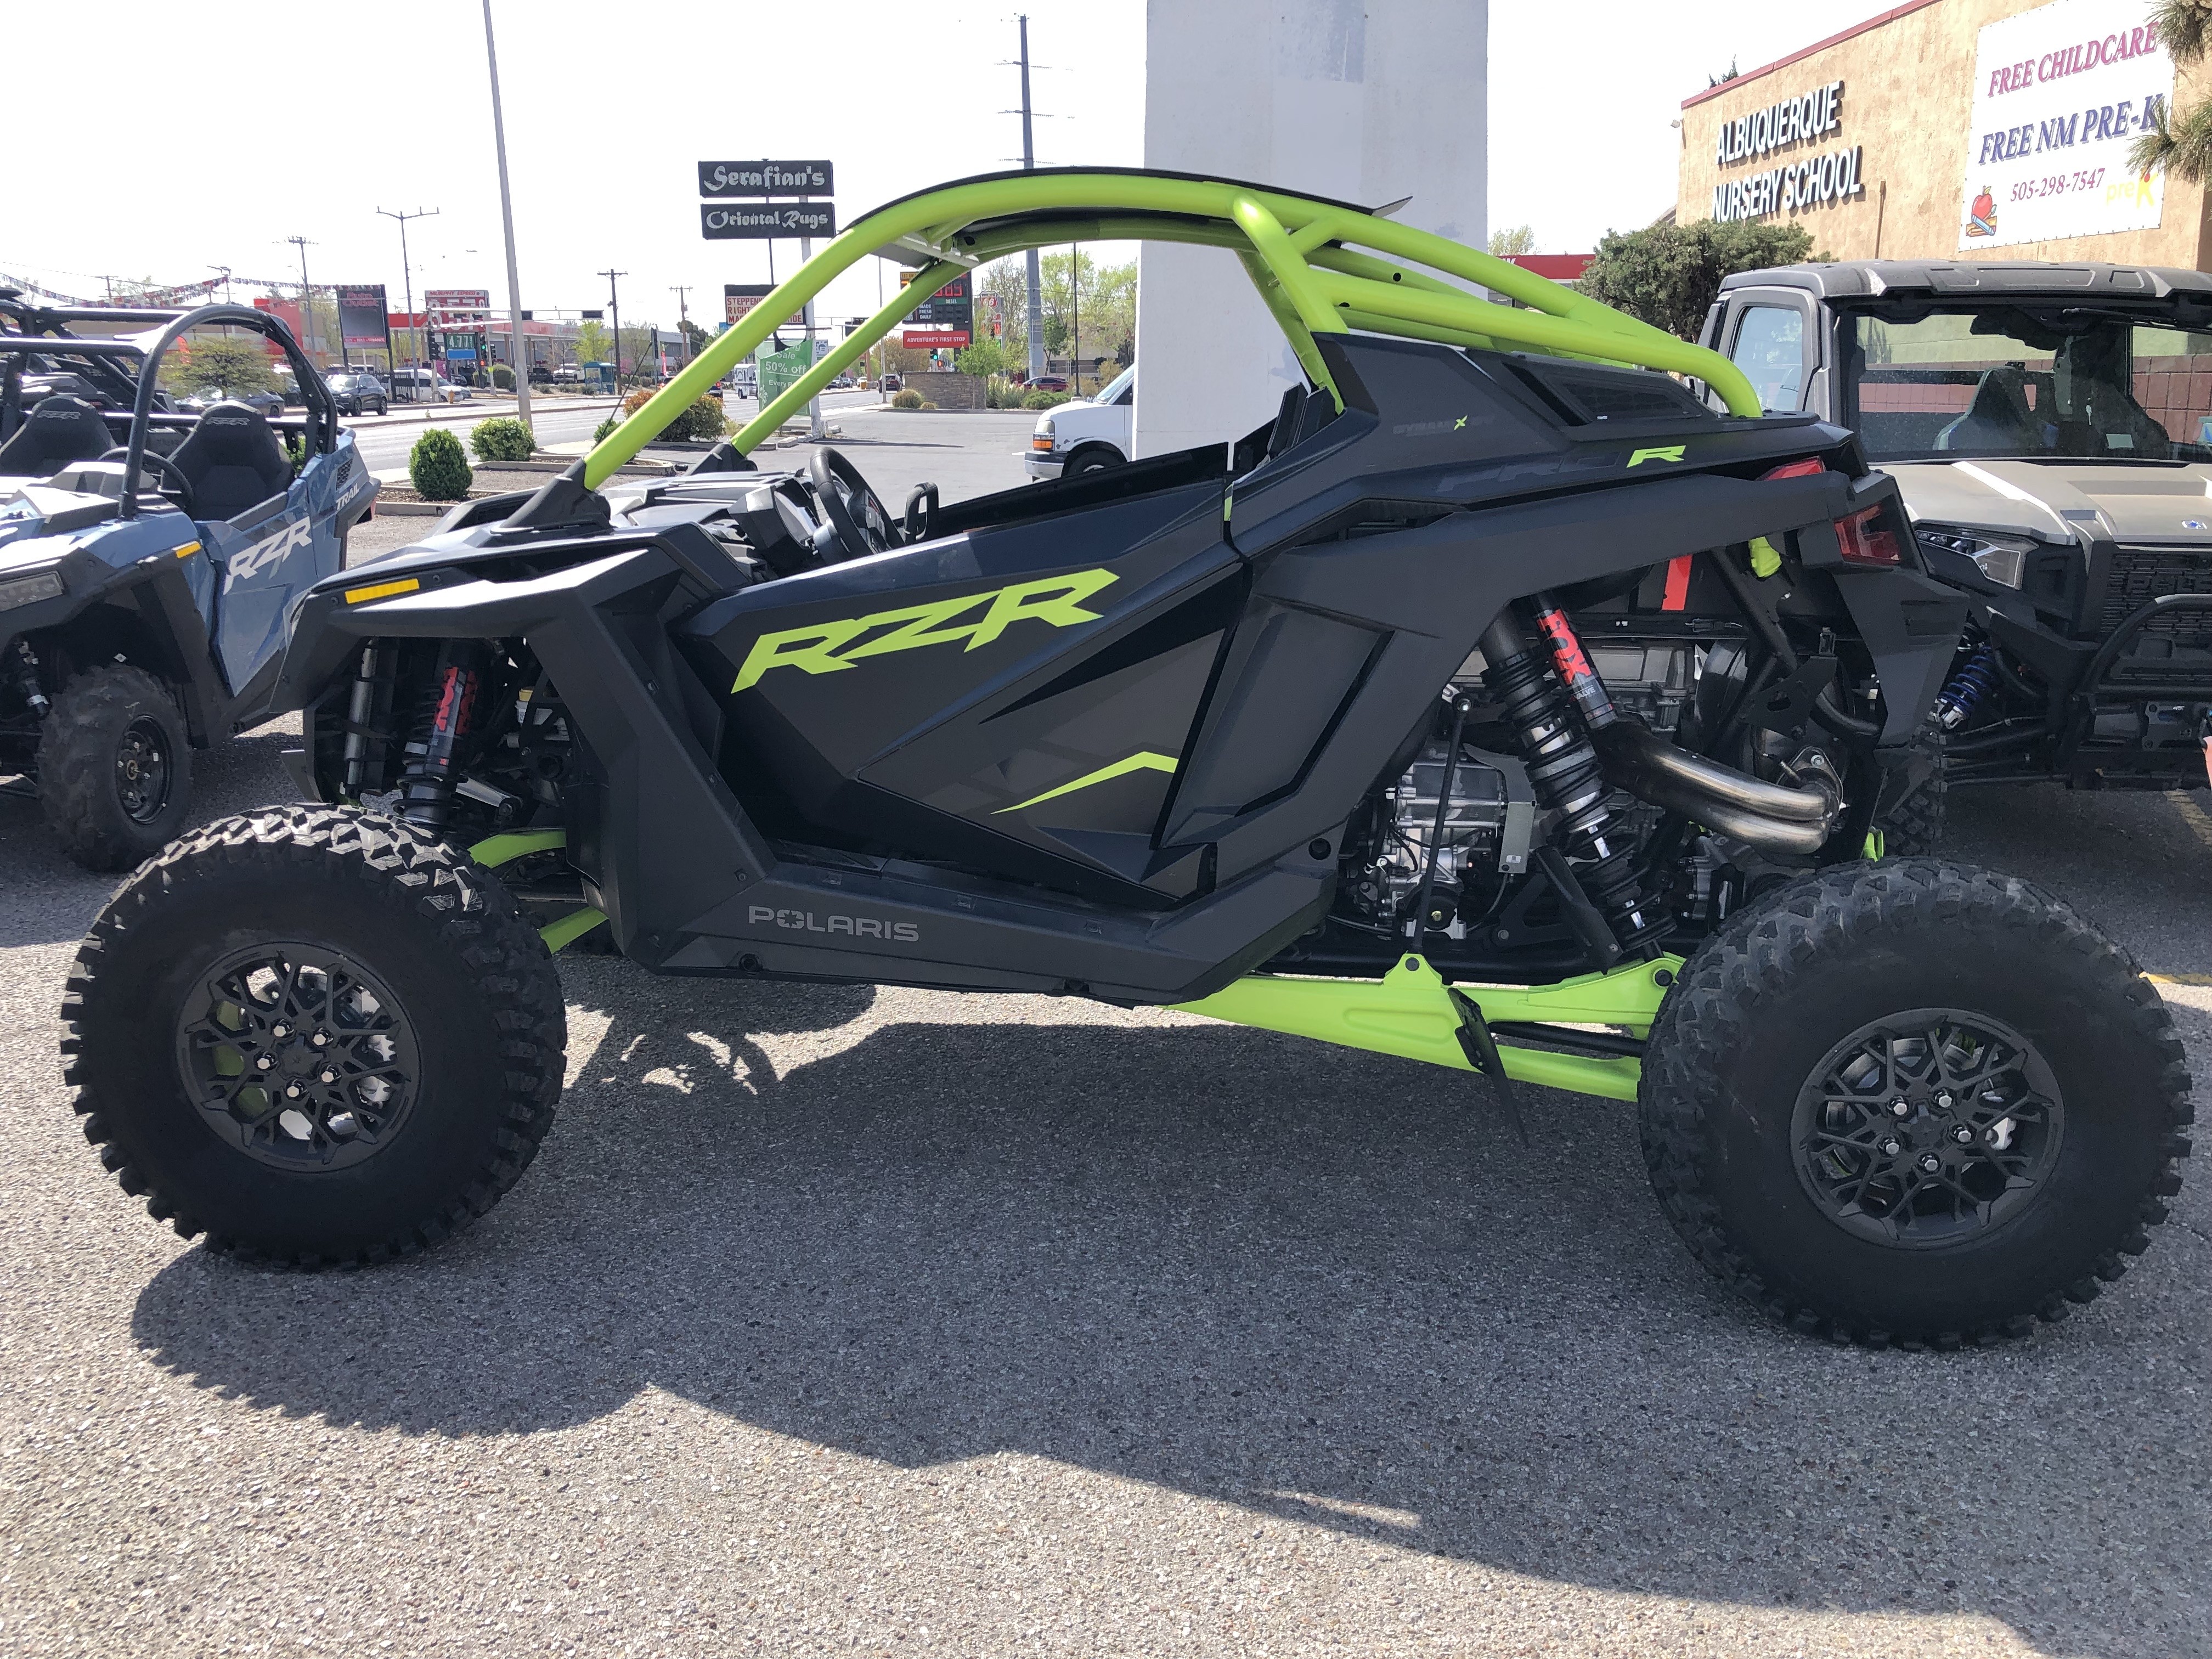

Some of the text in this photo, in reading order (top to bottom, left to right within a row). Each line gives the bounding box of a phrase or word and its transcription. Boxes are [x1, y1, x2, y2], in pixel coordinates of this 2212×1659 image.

[1988, 21, 2160, 98] FREE CHILDCARE
[1716, 80, 1841, 165] ALBUQUERQUE
[1978, 93, 2167, 165] FREE NM PRE-K
[704, 166, 825, 191] Serafian's
[1711, 145, 1862, 223] NURSERY SCHOOL
[2011, 167, 2106, 202] 505-298-7547
[706, 210, 828, 229] Oriental Rugs
[765, 361, 806, 374] 50% off
[769, 379, 787, 388] Every
[336, 483, 359, 511] TRAIL
[223, 516, 313, 595] RZR
[731, 568, 1120, 695] RZR
[748, 905, 920, 942] POLARIS
